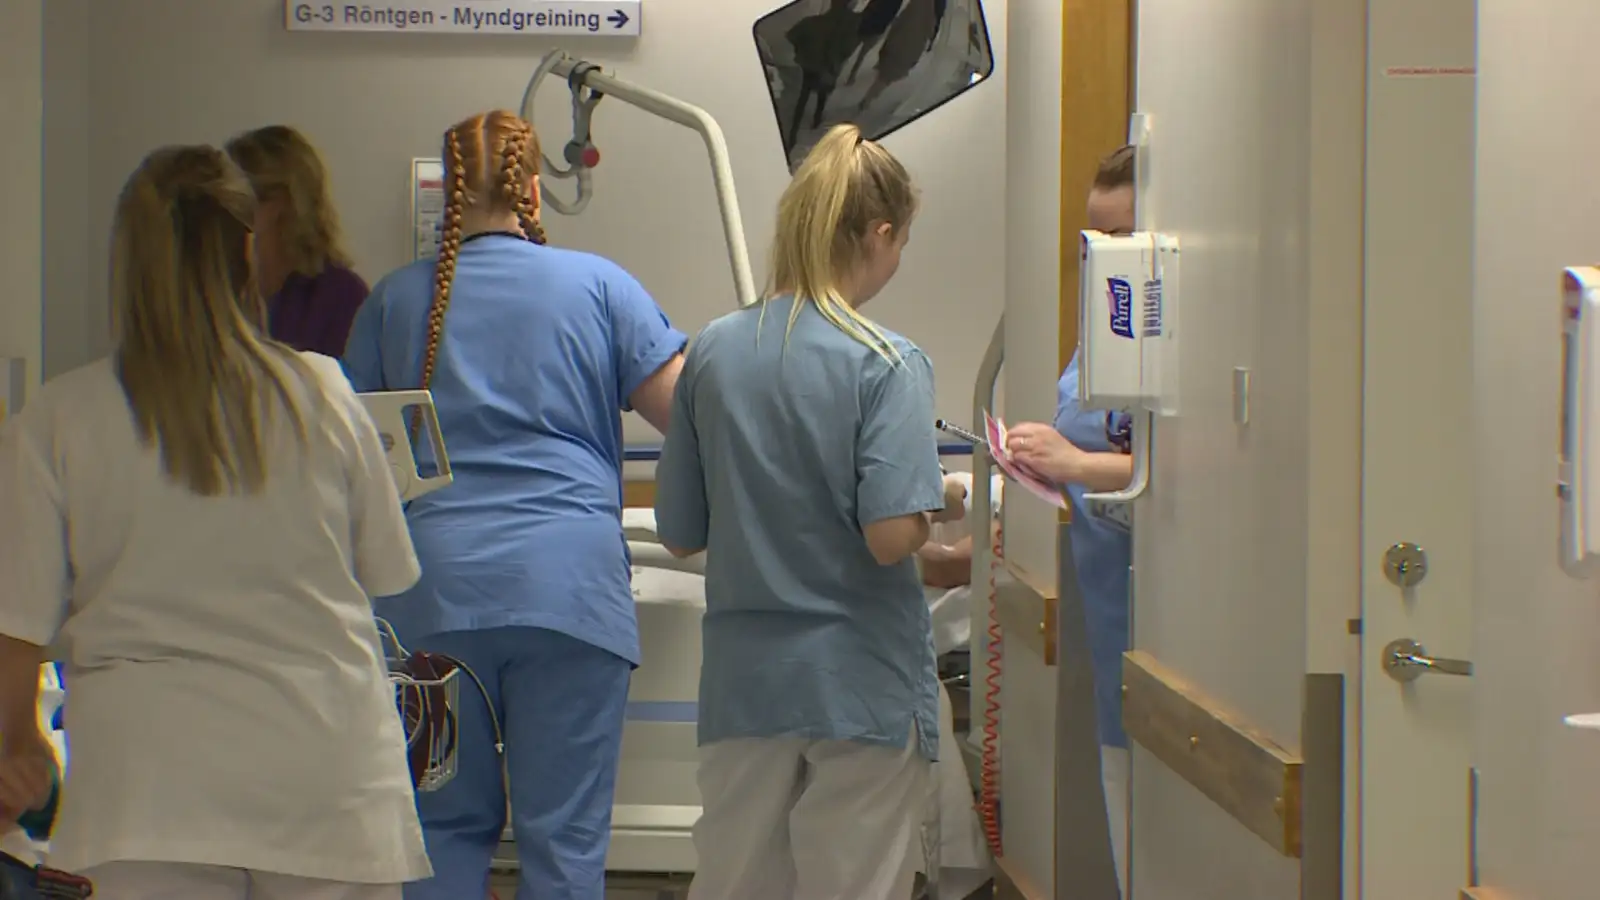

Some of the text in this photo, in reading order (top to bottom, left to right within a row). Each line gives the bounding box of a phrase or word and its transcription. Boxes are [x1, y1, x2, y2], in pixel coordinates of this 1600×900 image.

[295, 4, 335, 23] G-3
[344, 4, 434, 28] Röntgen
[453, 7, 600, 31] Myndgreining
[1112, 284, 1130, 332] Purell
